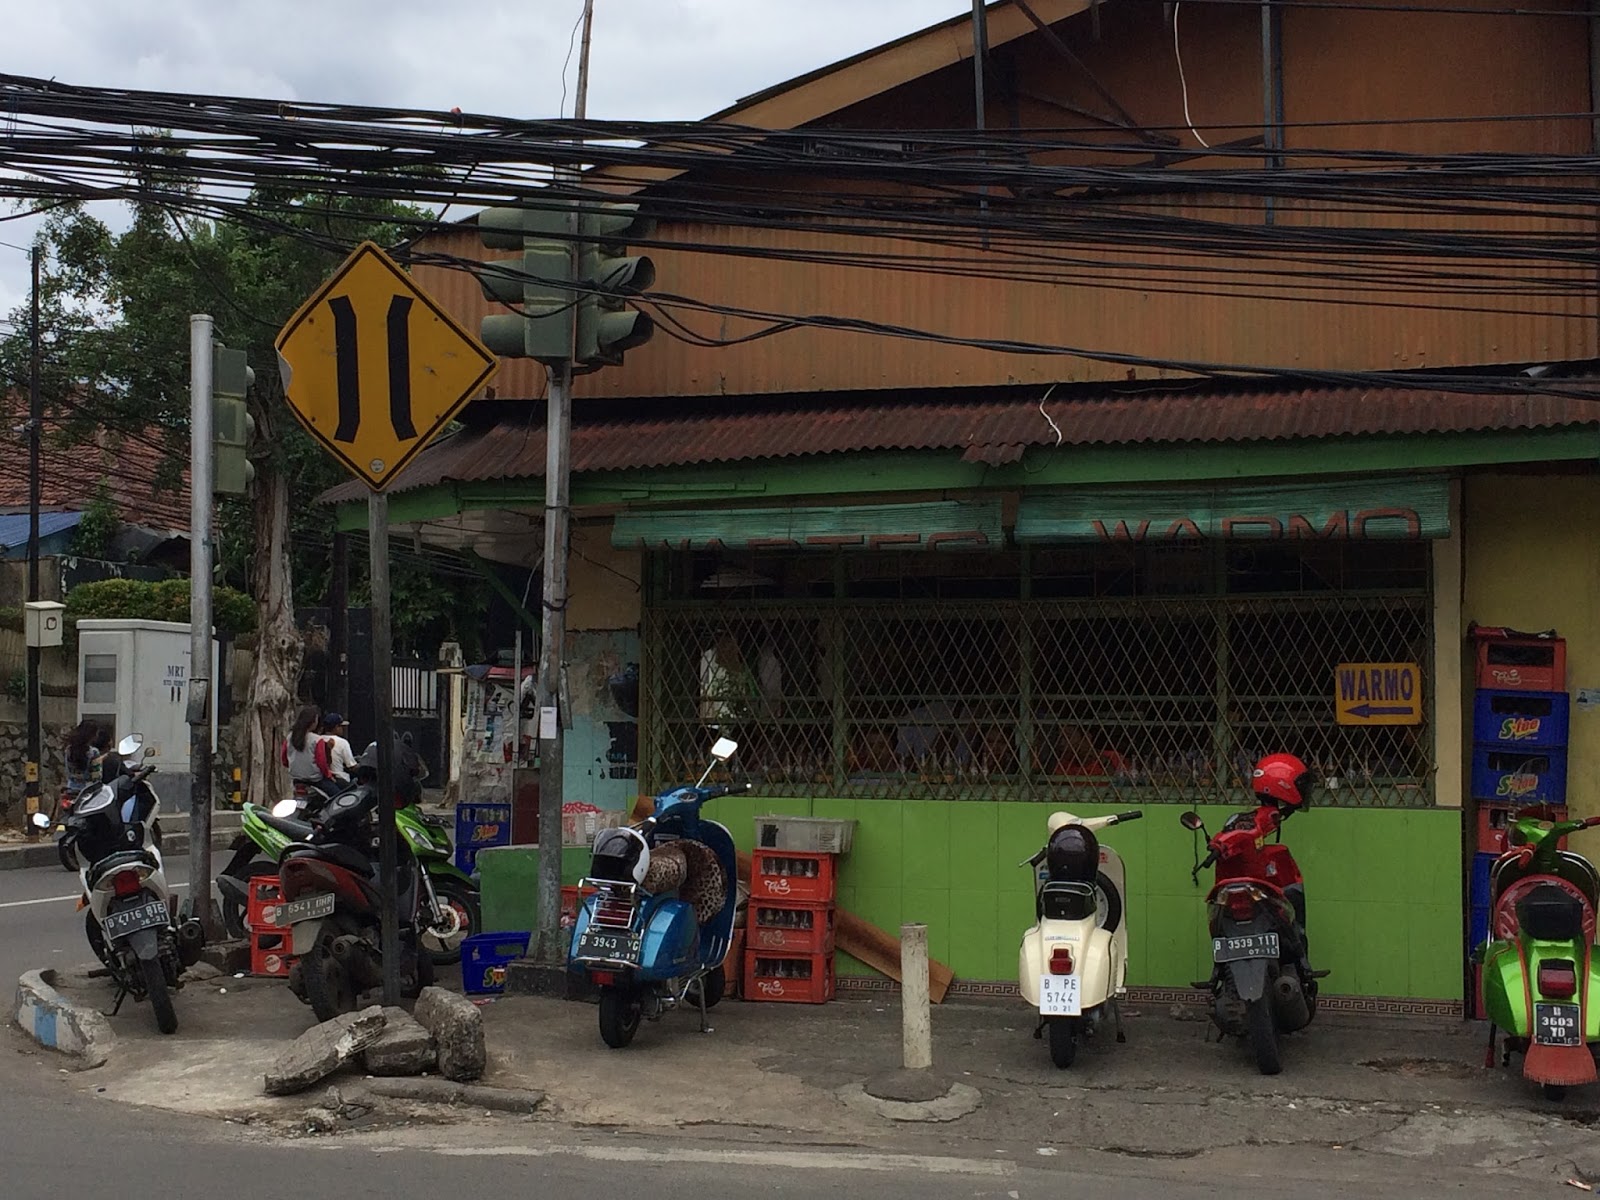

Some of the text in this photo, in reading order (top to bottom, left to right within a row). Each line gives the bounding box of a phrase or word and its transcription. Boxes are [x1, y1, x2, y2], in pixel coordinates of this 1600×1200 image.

[167, 665, 185, 677] MRT
[1340, 668, 1414, 700] WARMO
[276, 907, 282, 917] B
[288, 900, 311, 914] 6541
[580, 935, 588, 946] B
[593, 936, 617, 949] 3943
[1212, 935, 1276, 950] B 3539 TIT
[1044, 979, 1076, 990] B PE
[1046, 992, 1073, 1003] 5744
